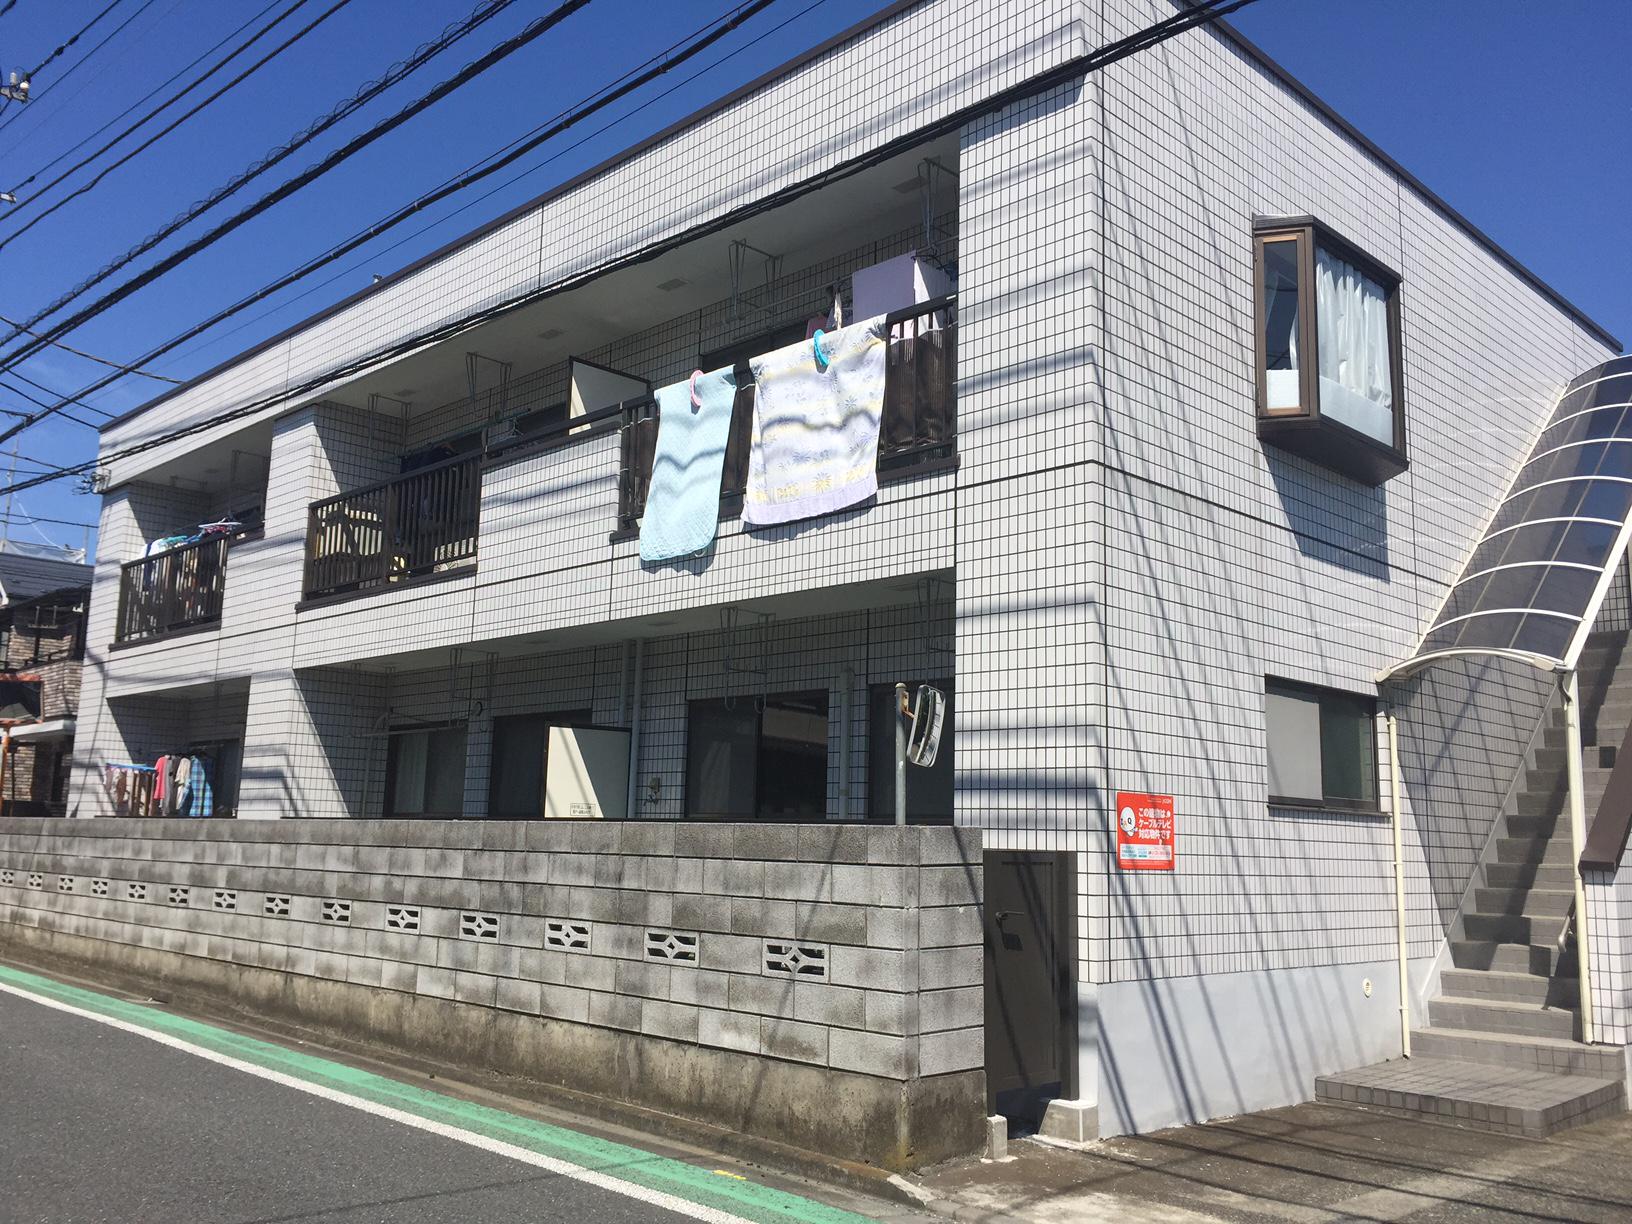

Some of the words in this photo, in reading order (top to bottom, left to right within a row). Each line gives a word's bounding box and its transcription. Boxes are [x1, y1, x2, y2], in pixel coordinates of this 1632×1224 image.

[1138, 818, 1172, 829] ケーブルテレビ
